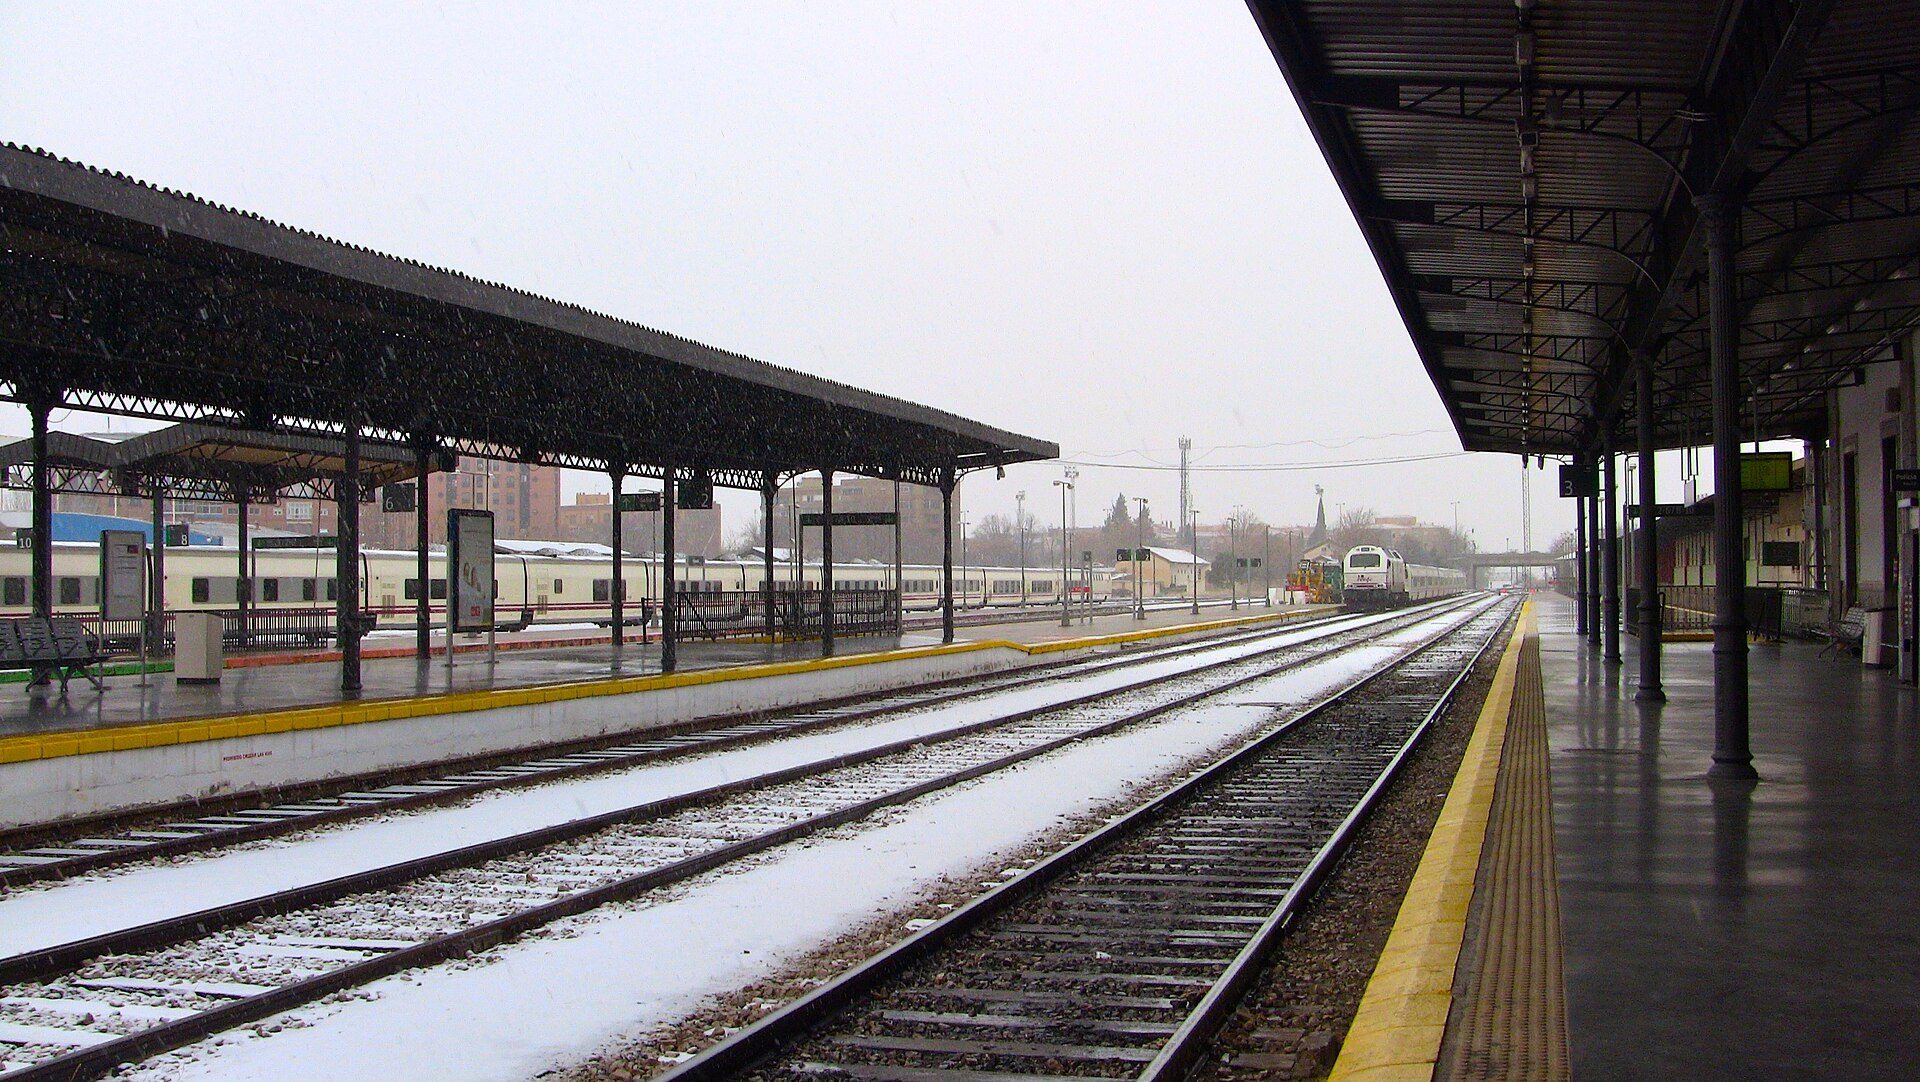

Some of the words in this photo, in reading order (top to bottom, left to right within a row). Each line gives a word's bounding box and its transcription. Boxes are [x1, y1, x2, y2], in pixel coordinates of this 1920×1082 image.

[1564, 480, 1573, 496] 3
[386, 496, 394, 510] 6
[701, 493, 709, 508] 2
[20, 537, 32, 548] 10
[181, 534, 188, 545] 8
